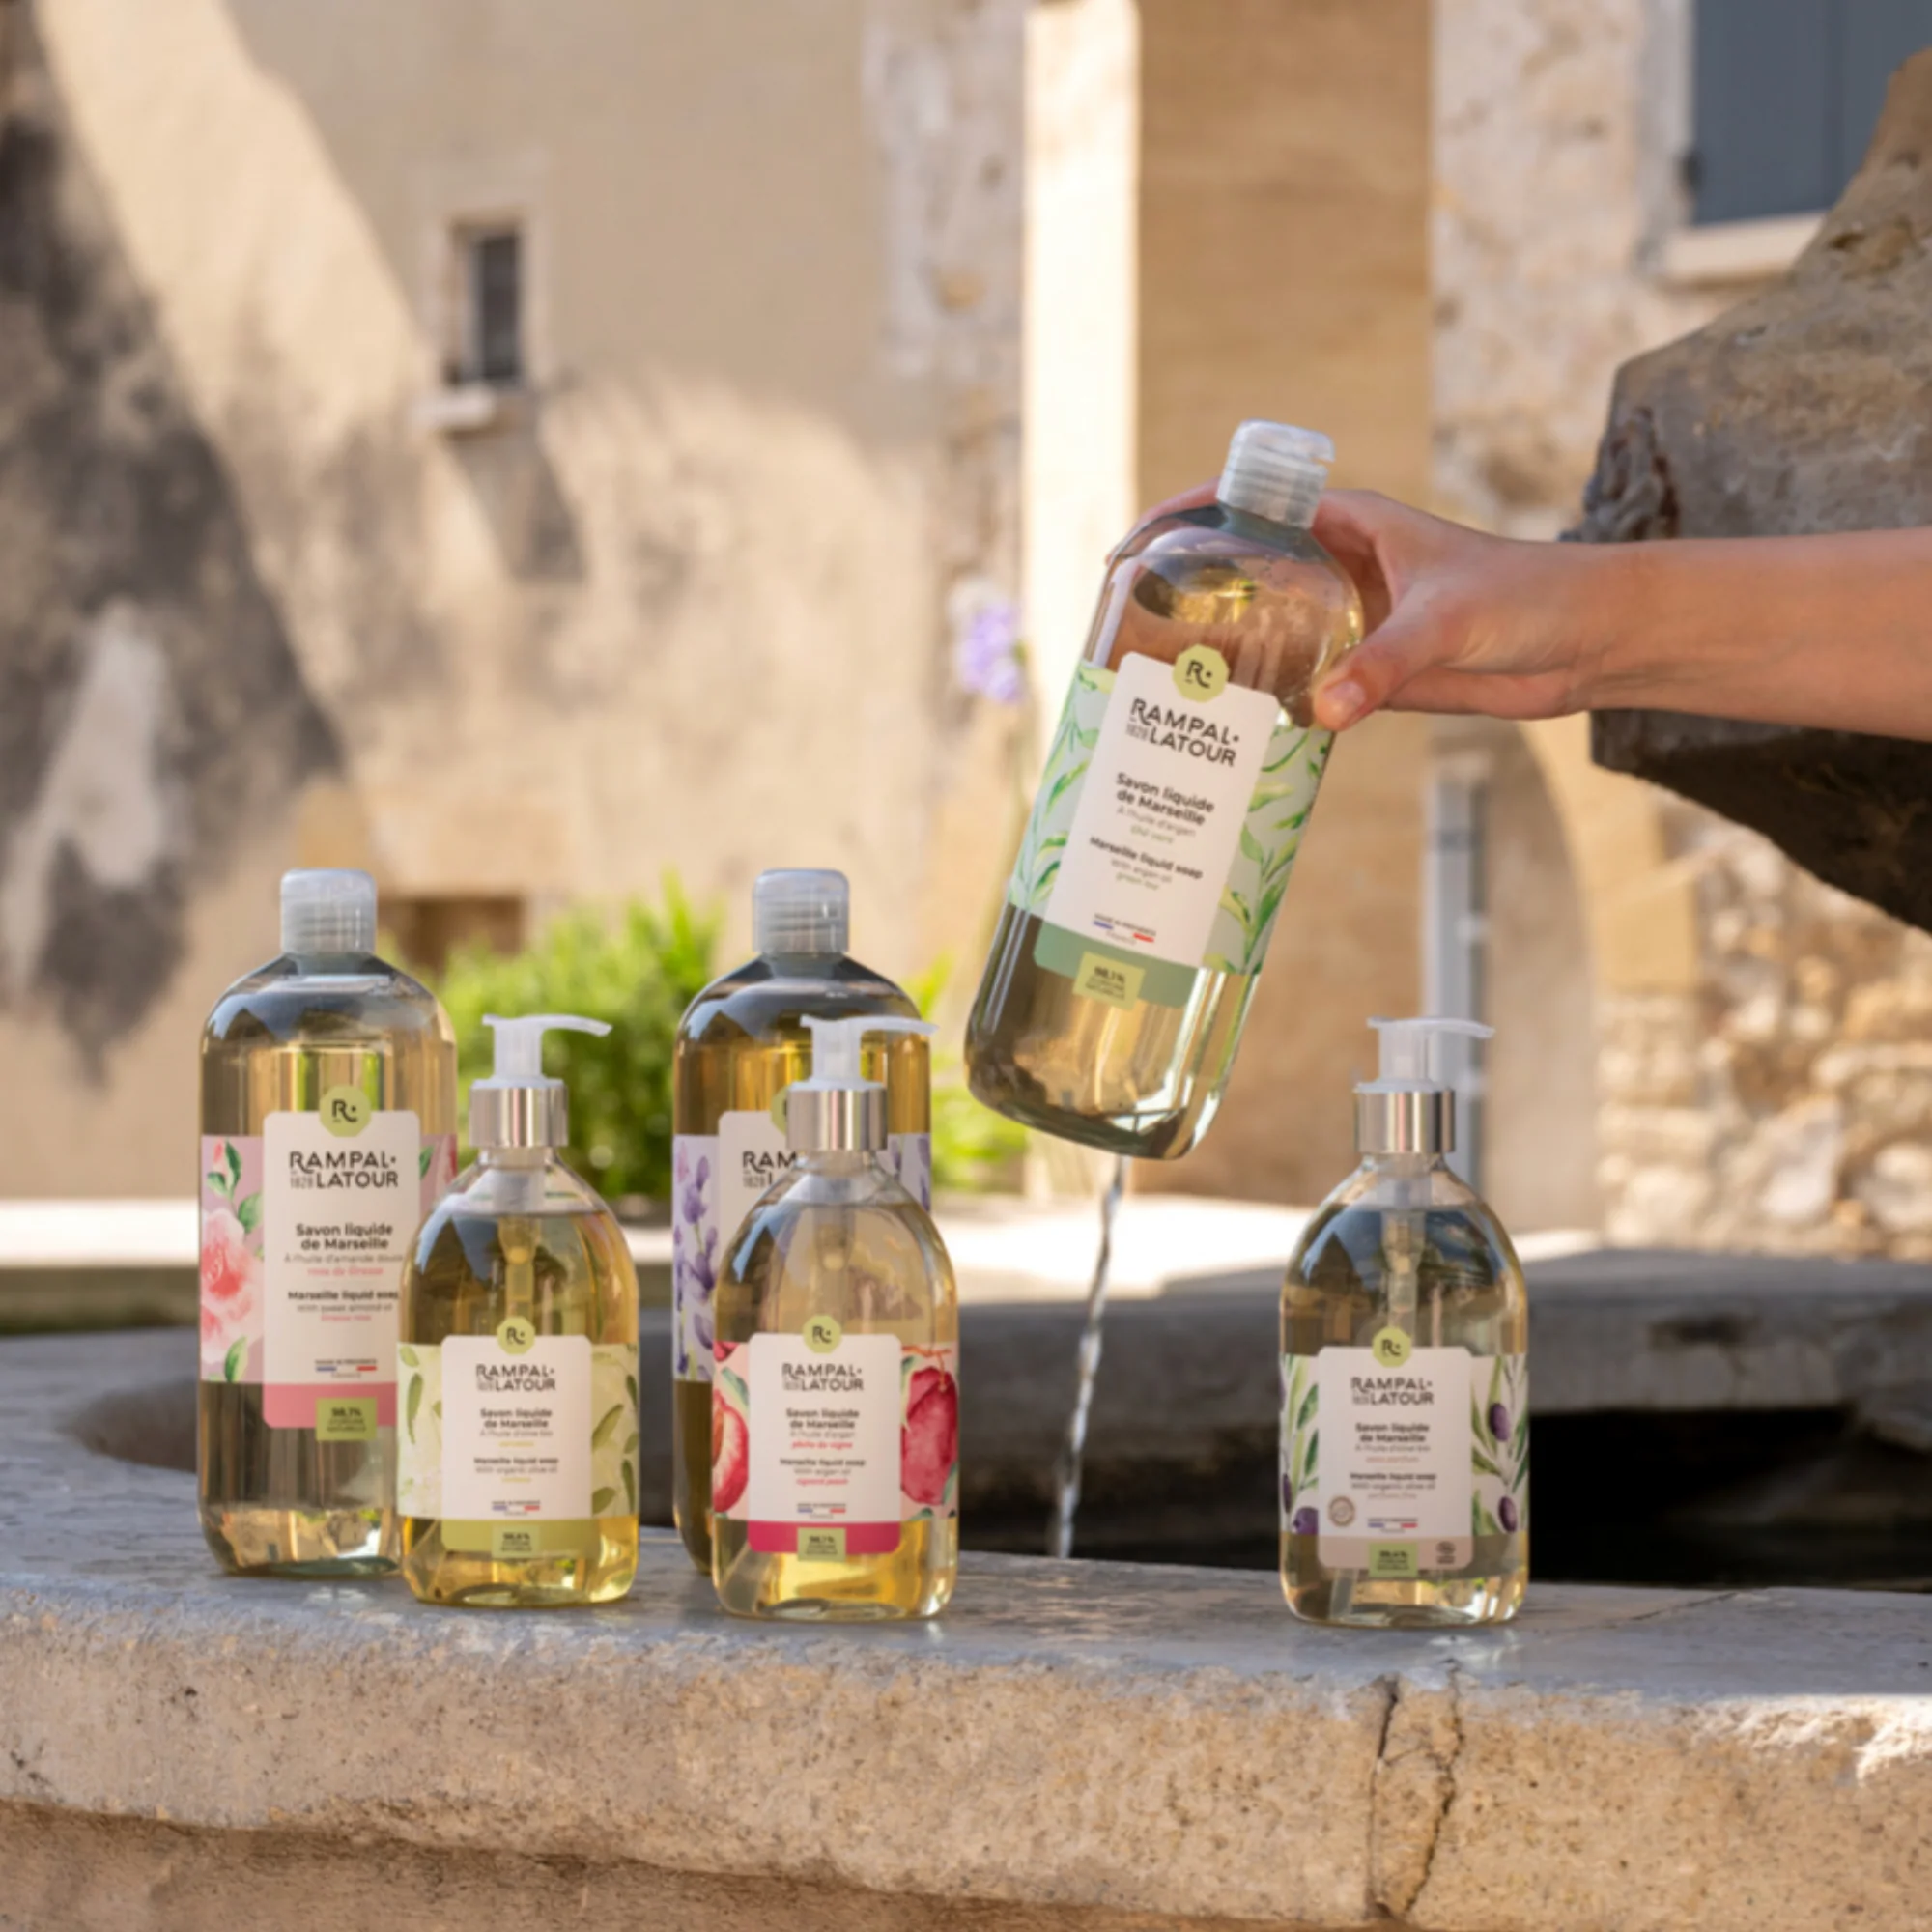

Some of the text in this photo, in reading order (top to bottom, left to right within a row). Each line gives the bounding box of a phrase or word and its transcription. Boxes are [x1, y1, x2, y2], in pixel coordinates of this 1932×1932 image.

[1131, 697, 1240, 747] RAMPAL
[1149, 726, 1236, 767] LATOUR
[1116, 772, 1215, 812] Savon liquide
[1116, 790, 1206, 826] de Marseille
[1090, 837, 1204, 880] Marseille liquid soap
[289, 1150, 397, 1174] RAMPAL
[316, 1171, 398, 1188] LATOUR
[296, 1222, 393, 1237] Savon liquide
[300, 1238, 388, 1250] de Marseille
[288, 1291, 338, 1299] Marseille
[342, 1290, 374, 1300] liquid
[496, 1378, 556, 1391] LATOUR
[802, 1378, 864, 1392] LATOUR
[1371, 1392, 1434, 1405] LATOUR
[480, 1408, 553, 1419] Savon liquide
[786, 1408, 860, 1420] Savon liquide
[484, 1419, 549, 1429] de Marseille
[790, 1420, 855, 1430] de Marseille
[1356, 1423, 1430, 1433] Savon liquide
[1377, 1434, 1426, 1443] Marseille
